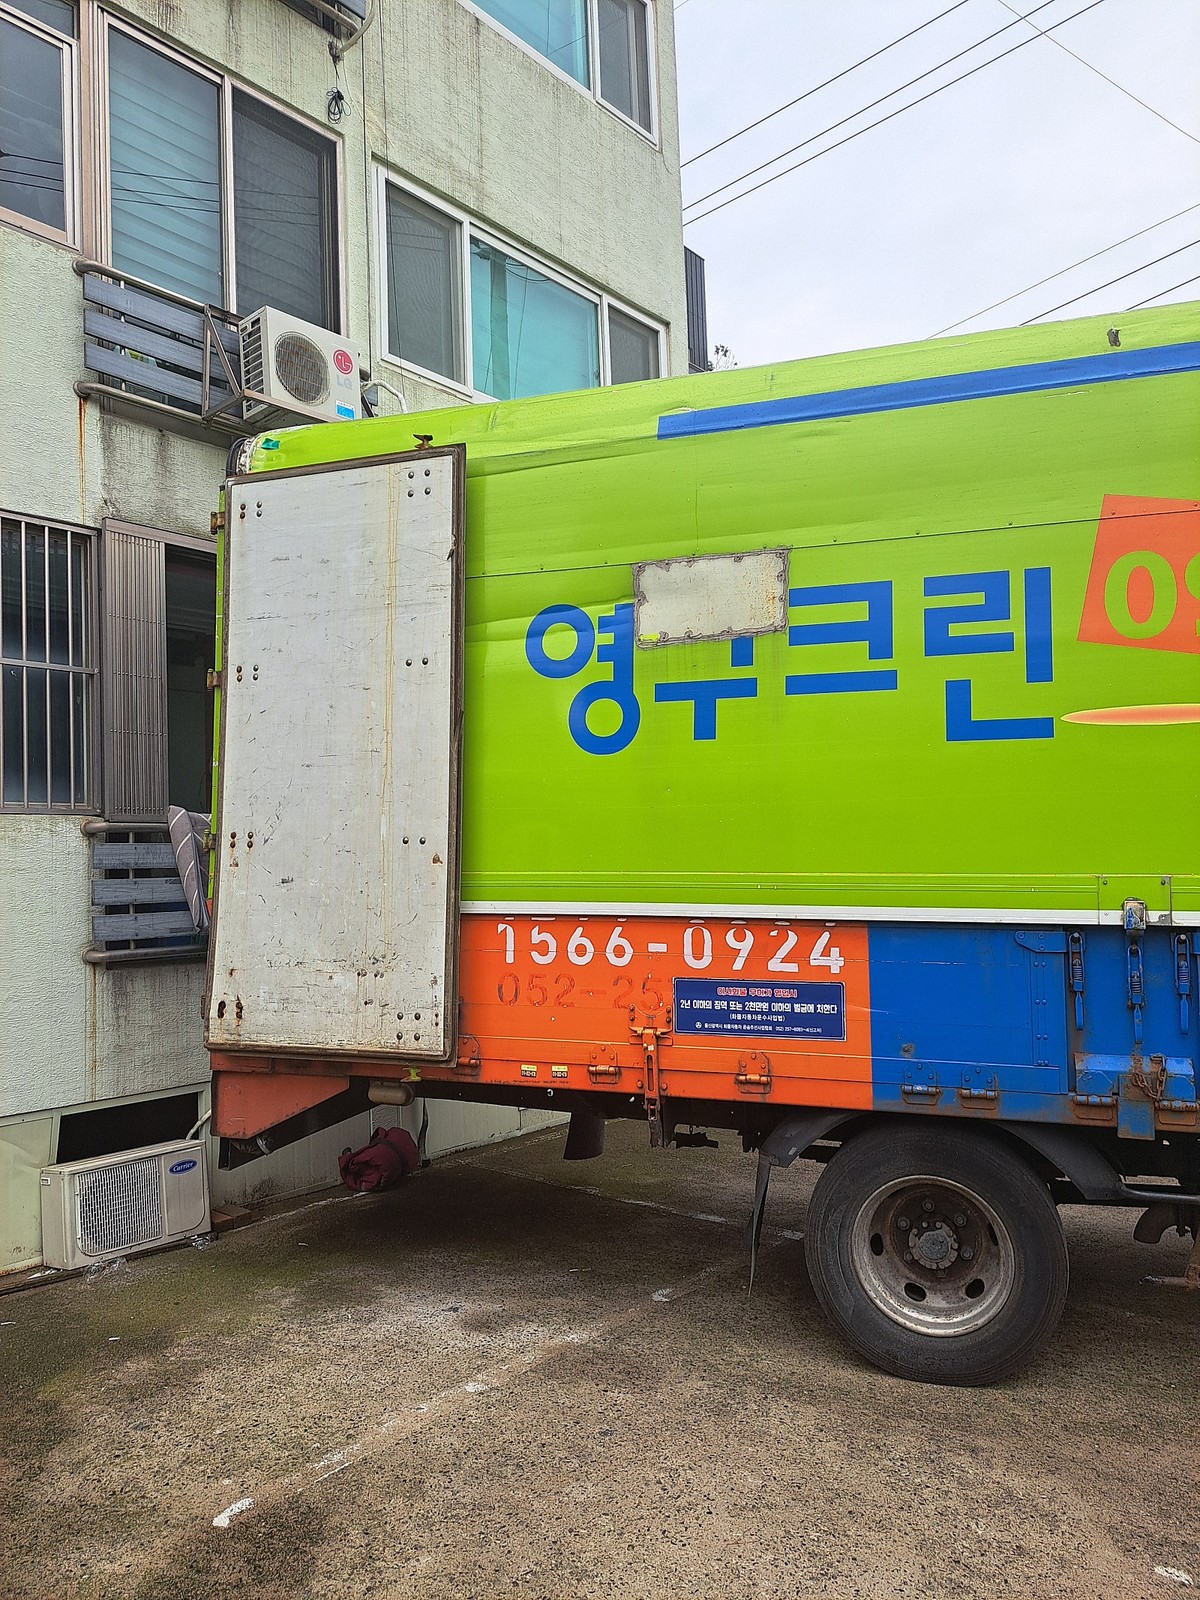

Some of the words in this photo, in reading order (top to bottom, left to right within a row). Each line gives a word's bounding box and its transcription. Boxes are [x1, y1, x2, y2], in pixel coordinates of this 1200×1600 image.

[1104, 549, 1200, 641] 0
[497, 916, 845, 974] 1566-0924
[680, 999, 691, 1009] 2년
[692, 1000, 712, 1010] 이하의
[714, 1000, 728, 1010] 징역
[729, 1001, 743, 1011] 또는
[744, 1002, 769, 1012] 2천만원
[771, 1003, 791, 1013] 이하의
[794, 1003, 815, 1014] 벌금에
[816, 1004, 838, 1014] 처한다
[729, 1013, 786, 1022] (화물자동차운수사업법)
[173, 1162, 194, 1172] Carrier
